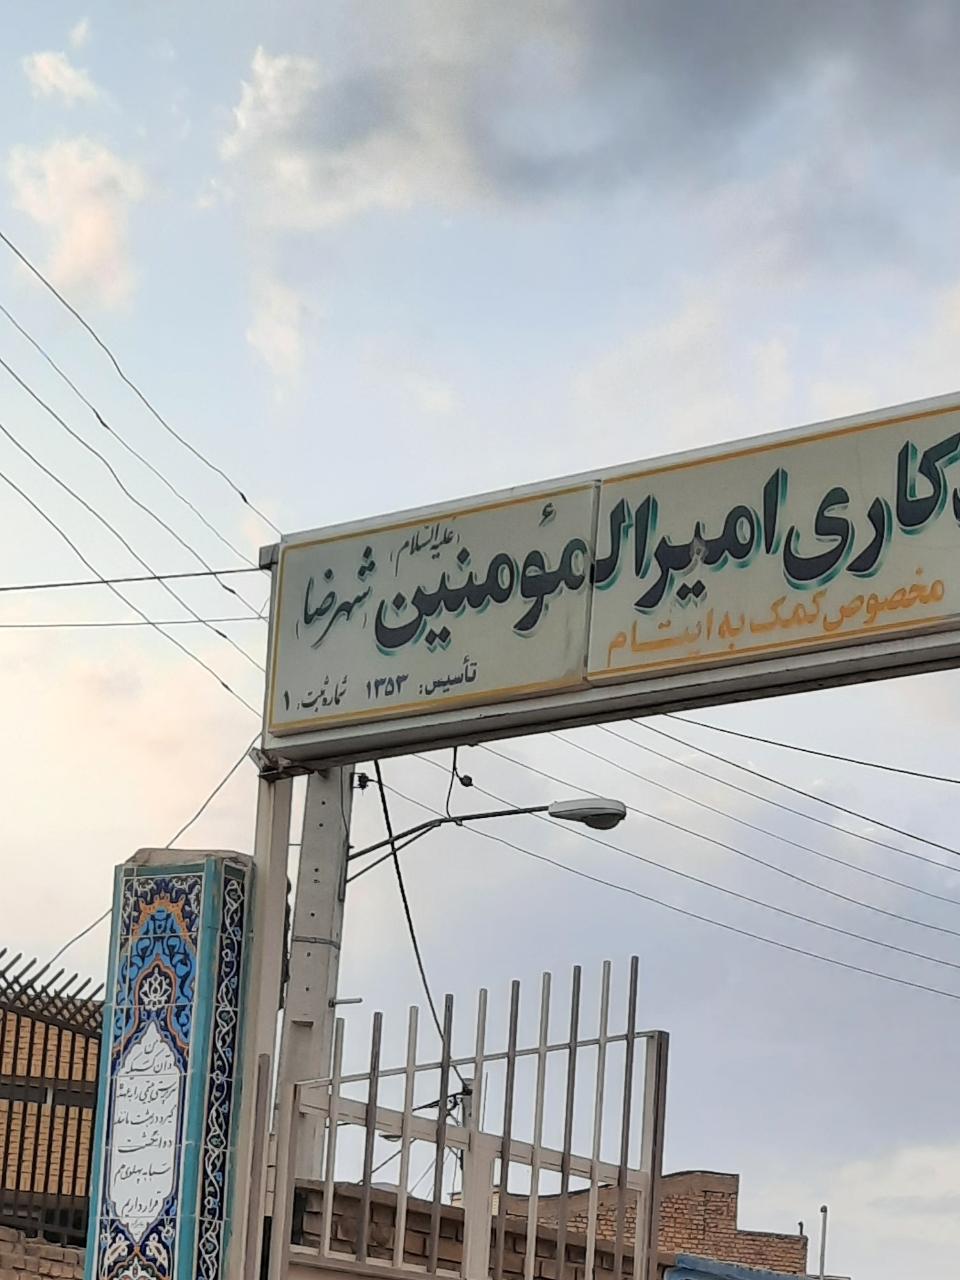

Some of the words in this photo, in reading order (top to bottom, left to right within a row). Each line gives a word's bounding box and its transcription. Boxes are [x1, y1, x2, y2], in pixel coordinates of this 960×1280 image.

[749, 587, 828, 635] کمک
[822, 567, 945, 632] مخصوص
[606, 607, 714, 668] ایتام
[717, 611, 746, 651] به
[283, 690, 290, 712] ۱
[365, 673, 409, 699] ۱۳۵۳
